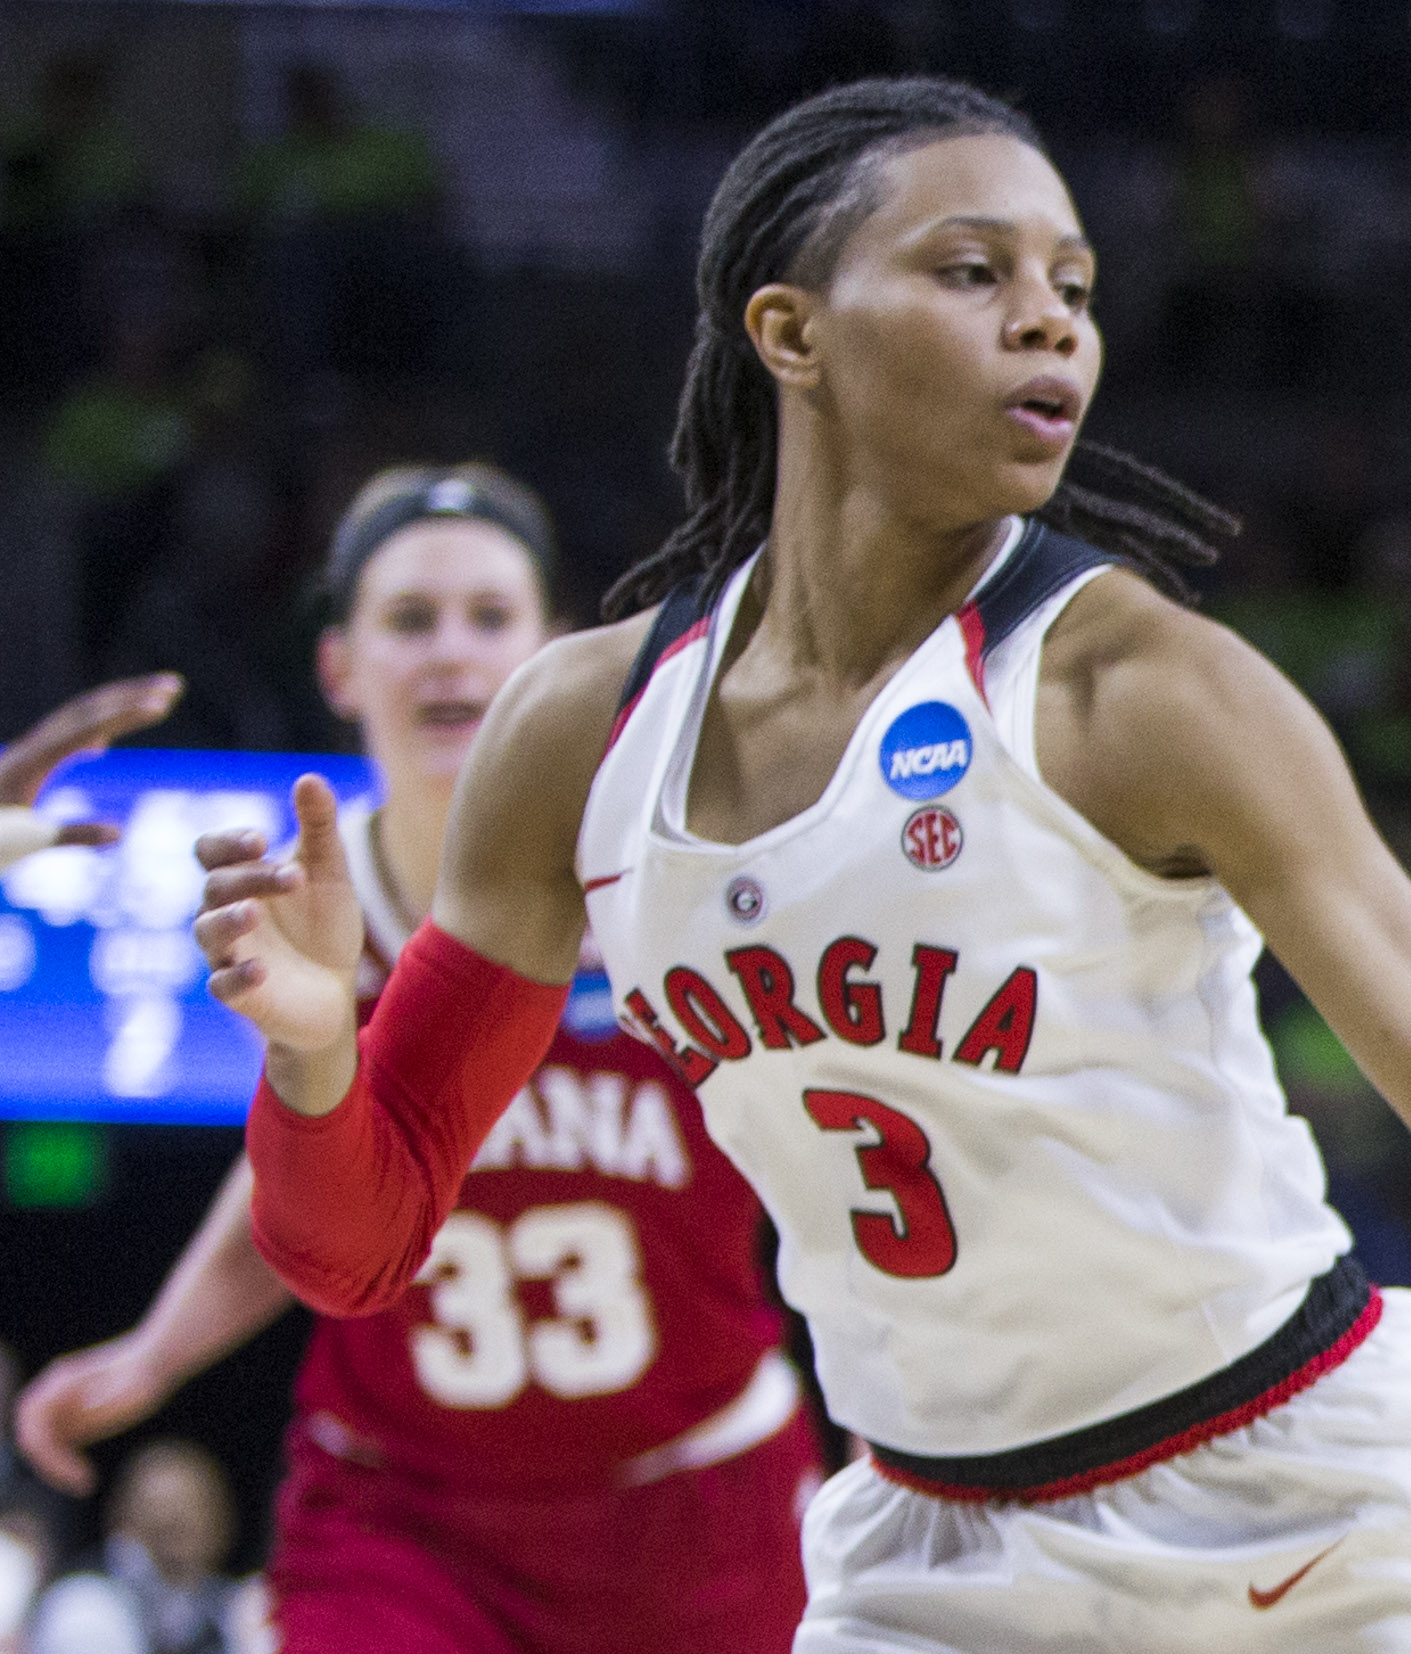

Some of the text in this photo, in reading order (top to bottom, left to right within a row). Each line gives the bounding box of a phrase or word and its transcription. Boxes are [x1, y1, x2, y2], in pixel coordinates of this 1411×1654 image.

[889, 738, 968, 780] NCAA
[906, 811, 958, 866] SEC
[802, 1087, 958, 1280] 3
[408, 1200, 661, 1412] 33
